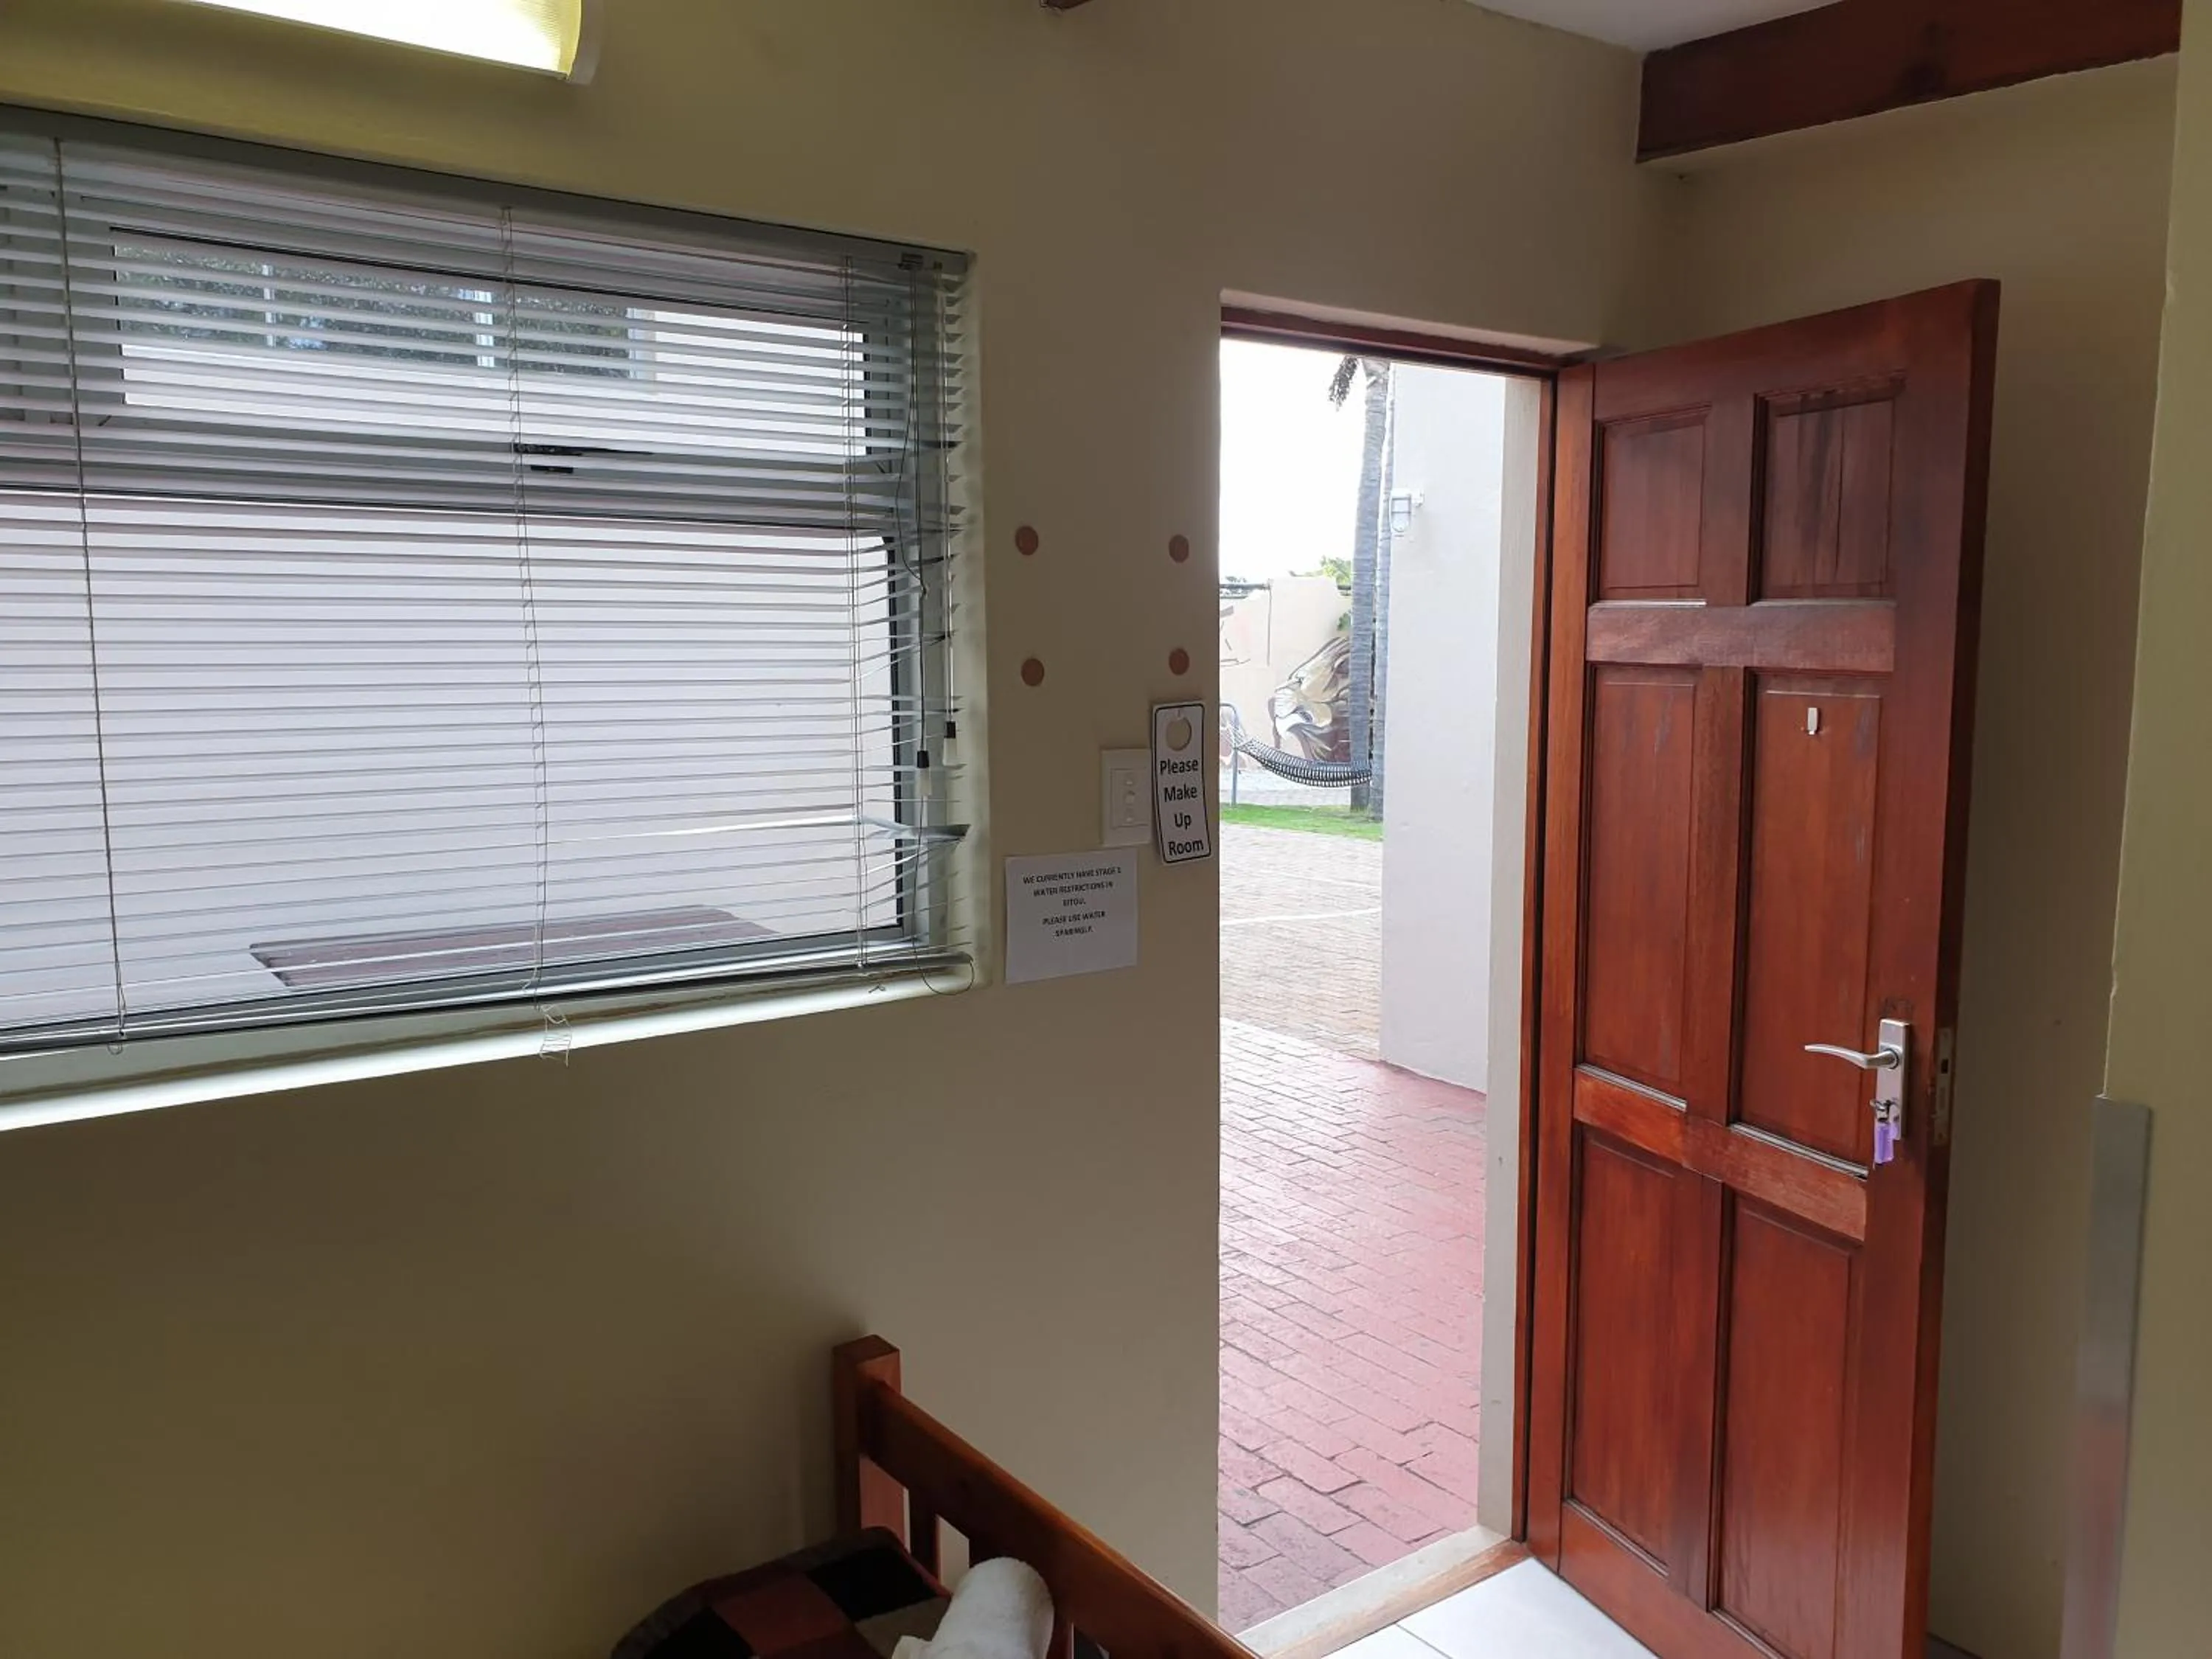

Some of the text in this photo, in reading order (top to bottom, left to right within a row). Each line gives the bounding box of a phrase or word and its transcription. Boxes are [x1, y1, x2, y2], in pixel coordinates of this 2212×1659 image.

[1160, 759, 1198, 774] Please
[1164, 784, 1198, 801] Make
[1175, 813, 1192, 830] Up
[1168, 839, 1204, 856] Room
[1023, 876, 1034, 884] WE
[1036, 872, 1074, 883] CURRENTLY
[1076, 869, 1094, 877] HAVE
[1096, 866, 1116, 876] STAGE
[1034, 888, 1057, 897] WATER
[1059, 882, 1105, 893] RESTRICTIONS
[1043, 911, 1106, 925] PLEASE USE WATER
